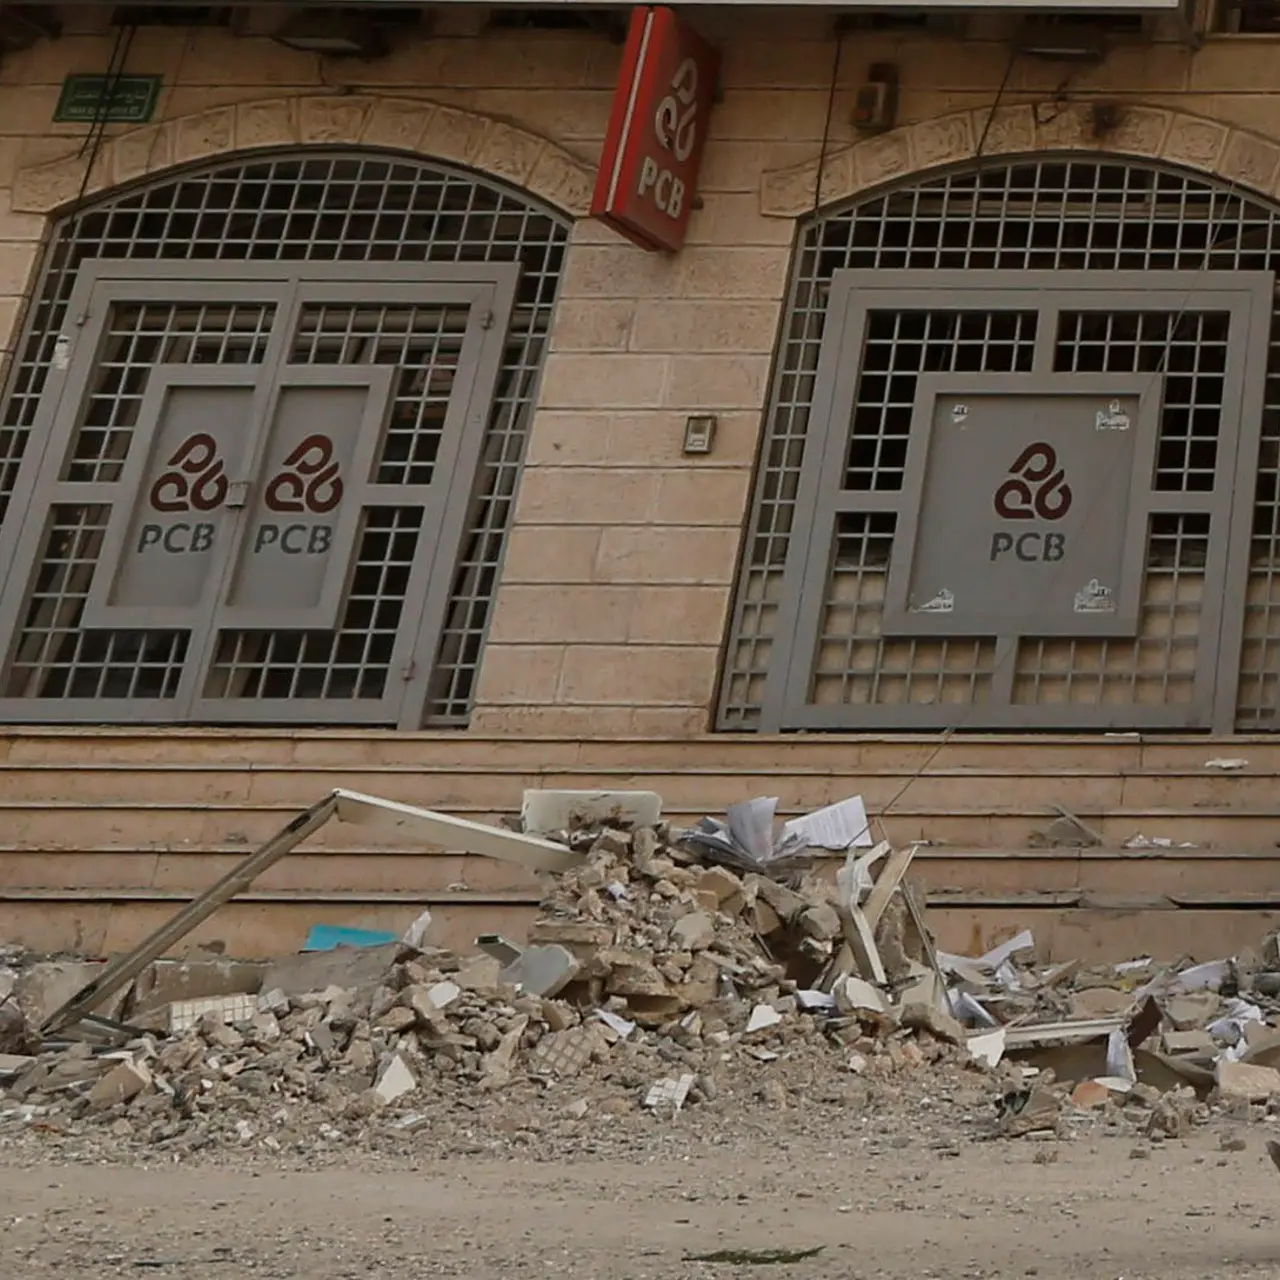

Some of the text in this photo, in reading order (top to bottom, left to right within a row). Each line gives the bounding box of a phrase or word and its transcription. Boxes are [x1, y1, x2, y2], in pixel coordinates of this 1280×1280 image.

[637, 156, 686, 220] PCB
[137, 523, 216, 554] PCB
[253, 524, 333, 555] PCB
[989, 531, 1067, 563] PCB
